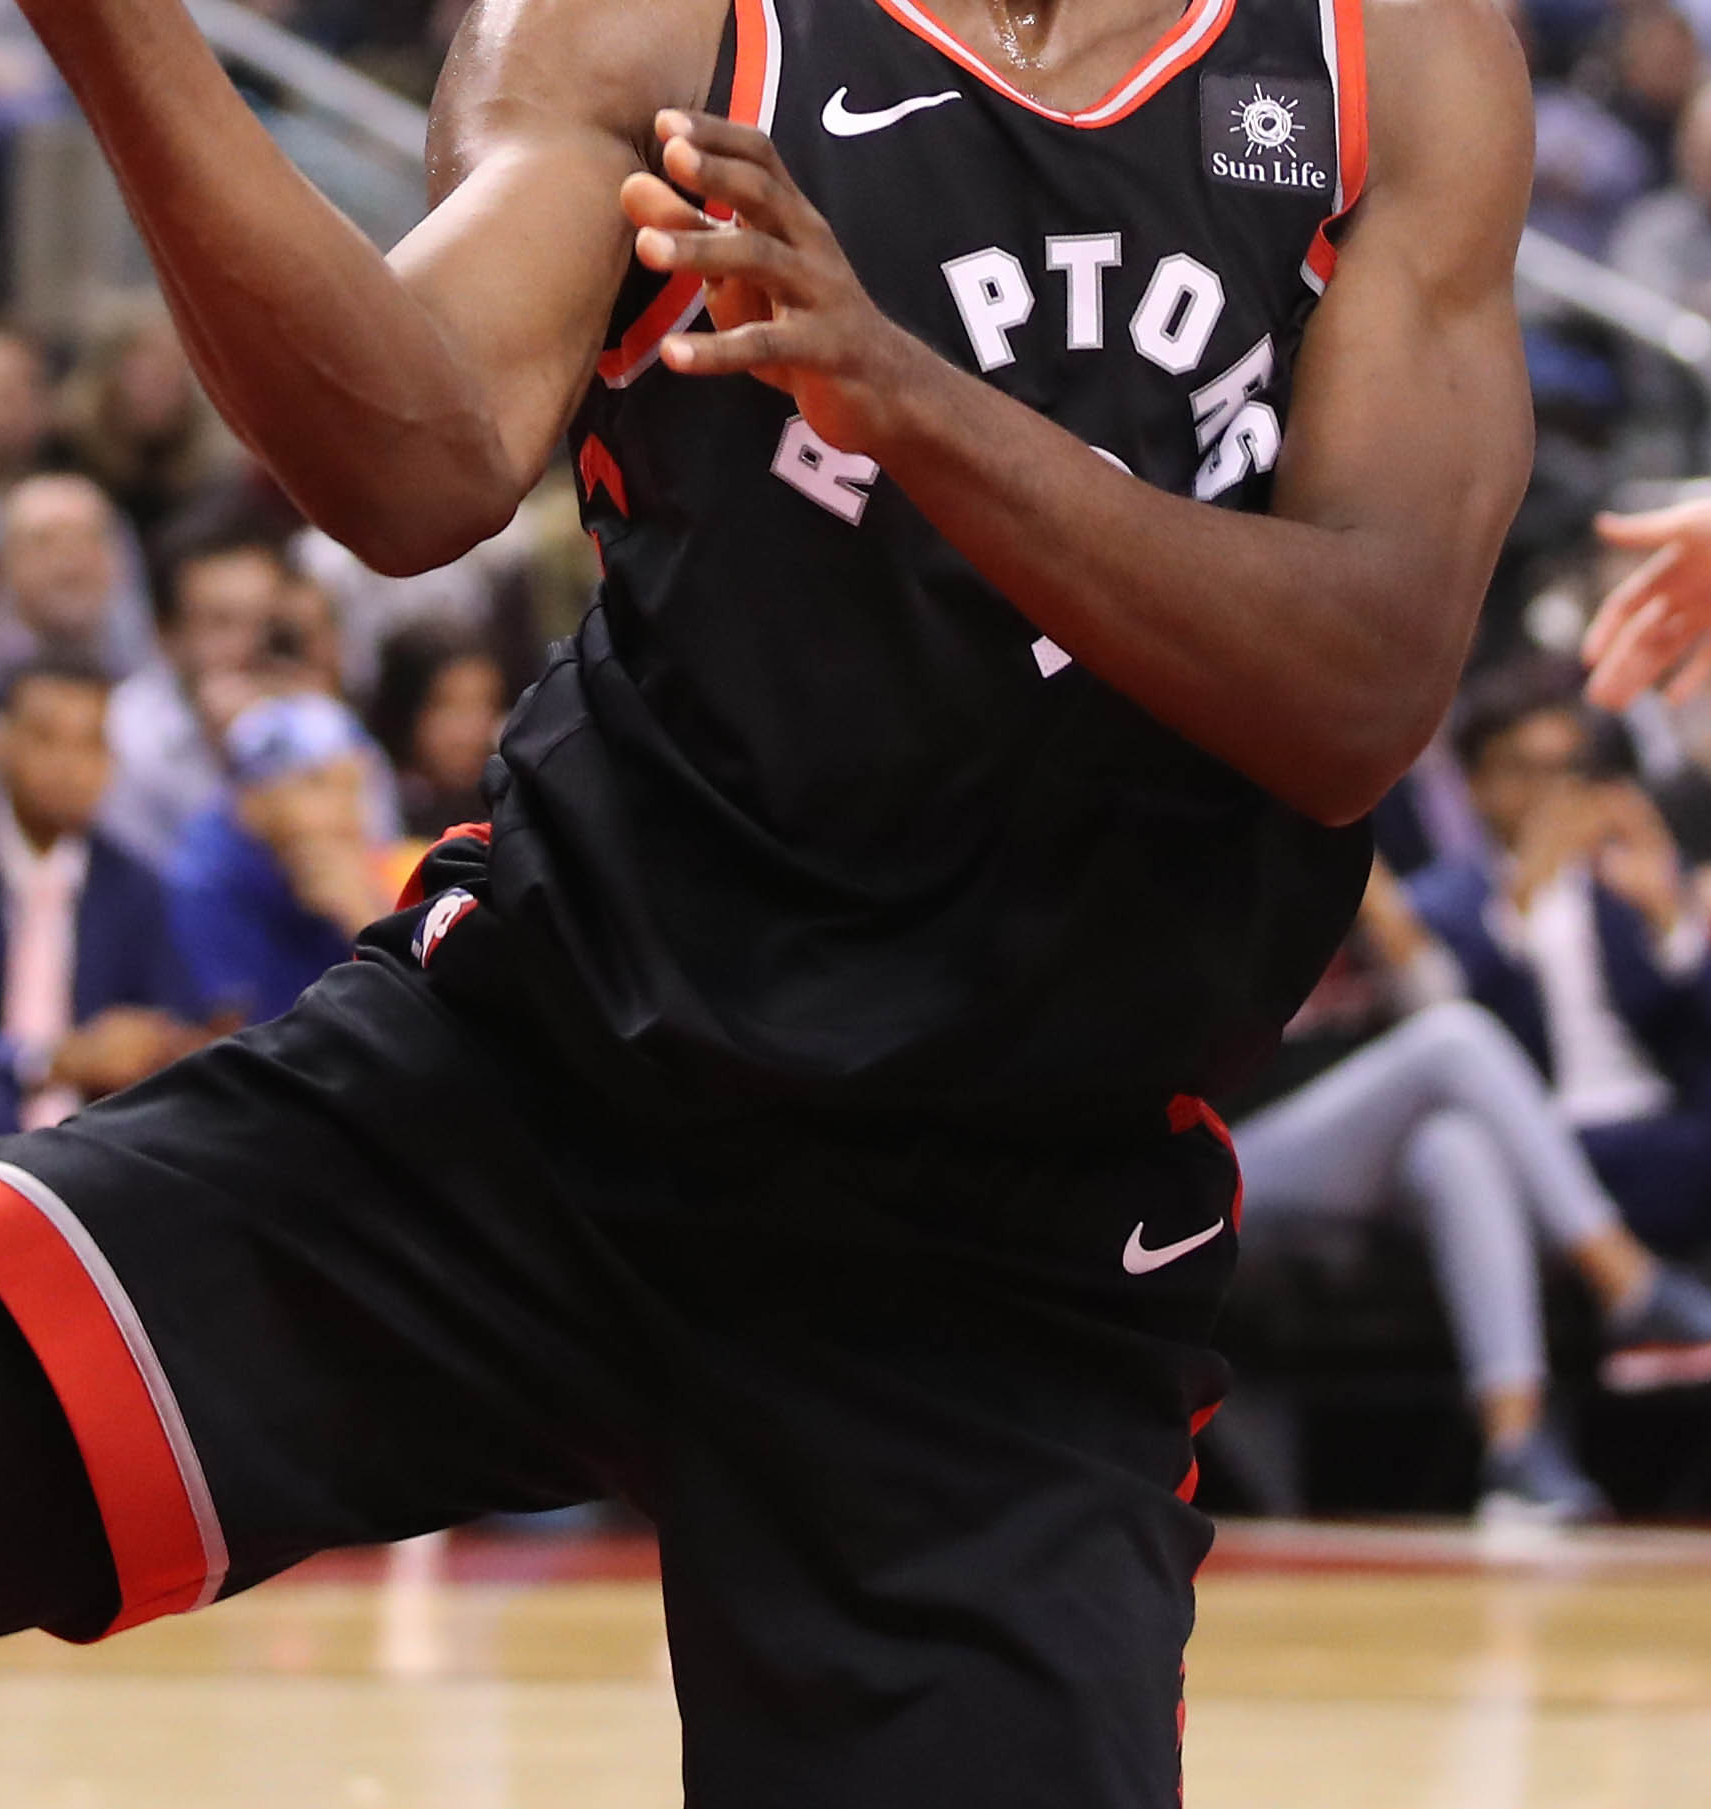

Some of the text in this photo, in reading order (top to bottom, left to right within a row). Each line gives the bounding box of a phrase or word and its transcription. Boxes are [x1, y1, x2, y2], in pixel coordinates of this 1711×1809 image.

[1212, 151, 1327, 189] Sun Life
[770, 231, 1282, 528] RPTORS
